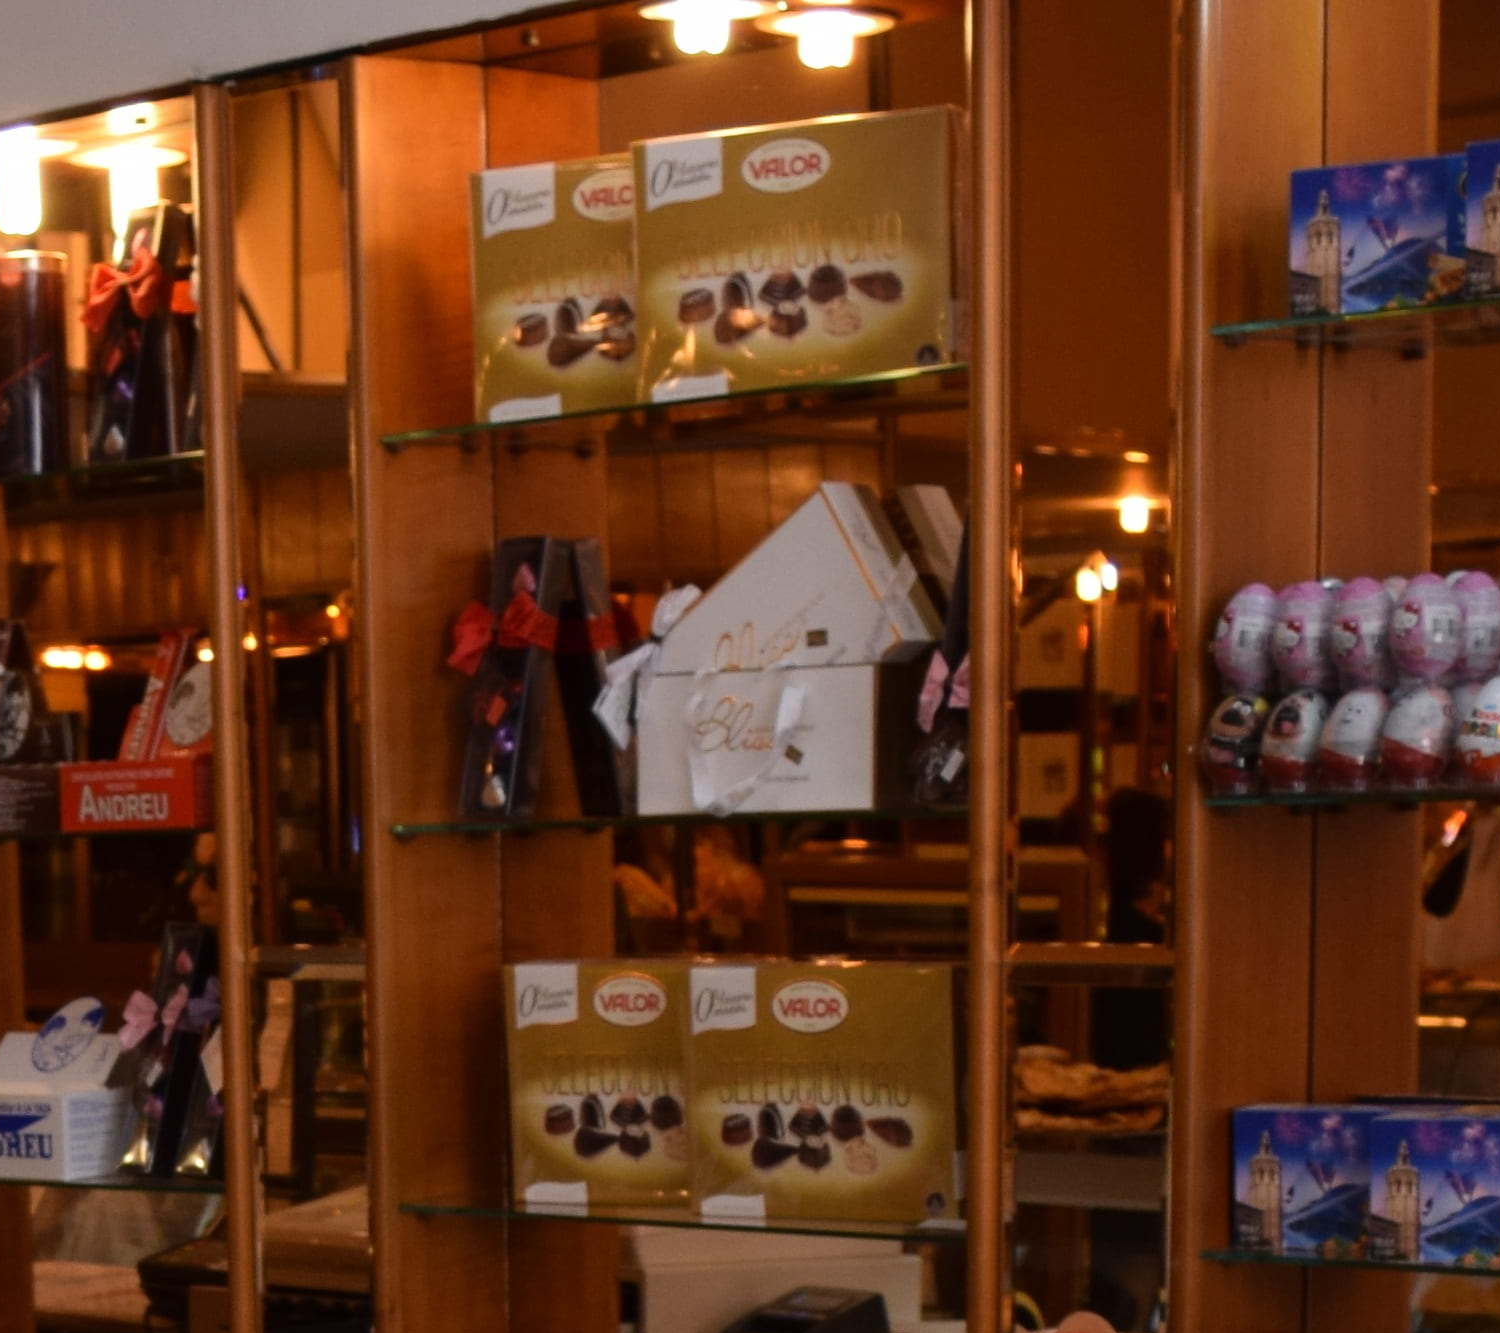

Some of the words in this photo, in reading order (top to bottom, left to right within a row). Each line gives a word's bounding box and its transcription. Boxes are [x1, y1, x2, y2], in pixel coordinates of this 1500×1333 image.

[748, 152, 824, 182] VALOR
[79, 784, 169, 823] ANDREU
[600, 993, 661, 1014] VALOR
[779, 998, 842, 1020] VALOR
